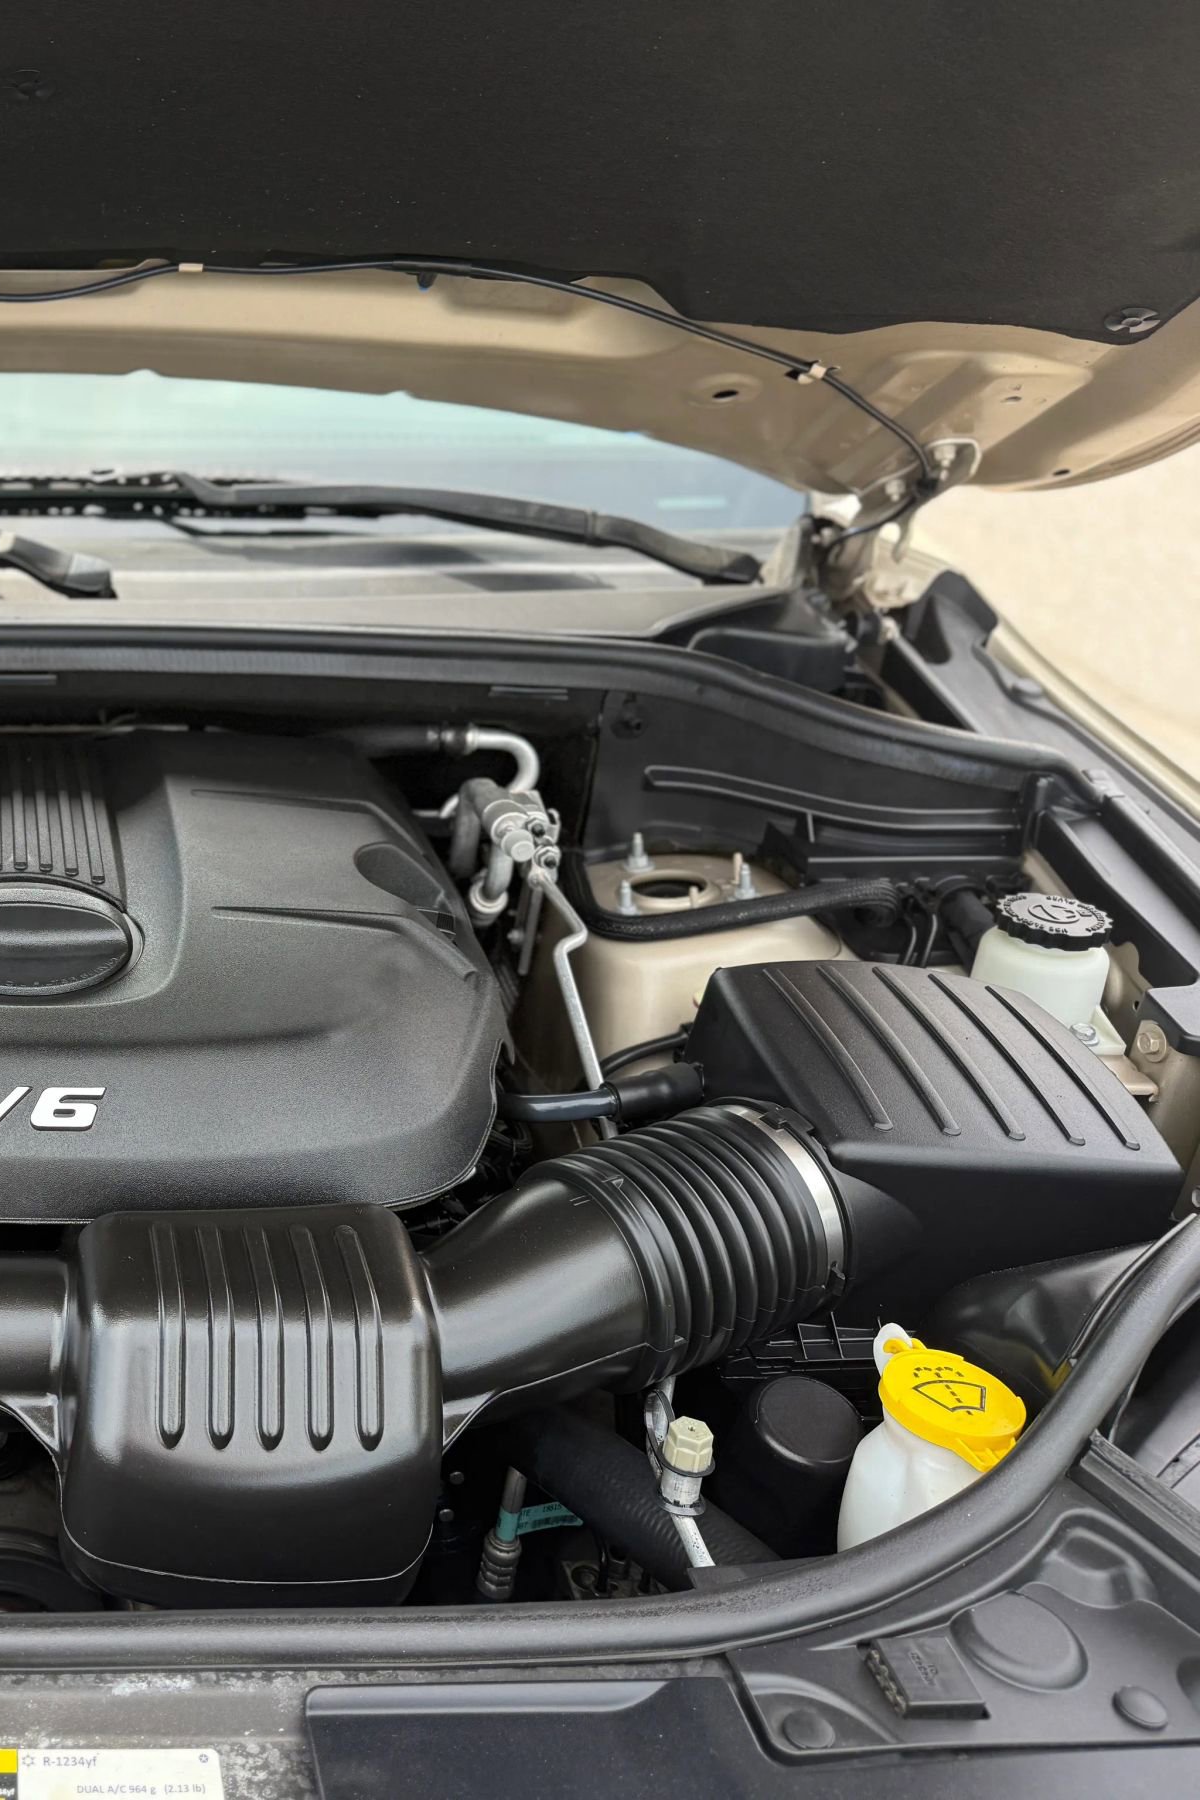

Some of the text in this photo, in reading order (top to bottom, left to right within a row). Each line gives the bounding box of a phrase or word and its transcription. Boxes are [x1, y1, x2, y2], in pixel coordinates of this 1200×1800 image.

[43, 1755, 97, 1768] R-1234yf
[76, 1785, 105, 1793] DUAL
[107, 1785, 127, 1793] A/C
[164, 1784, 190, 1794] (2.13
[192, 1784, 206, 1794] lb)
